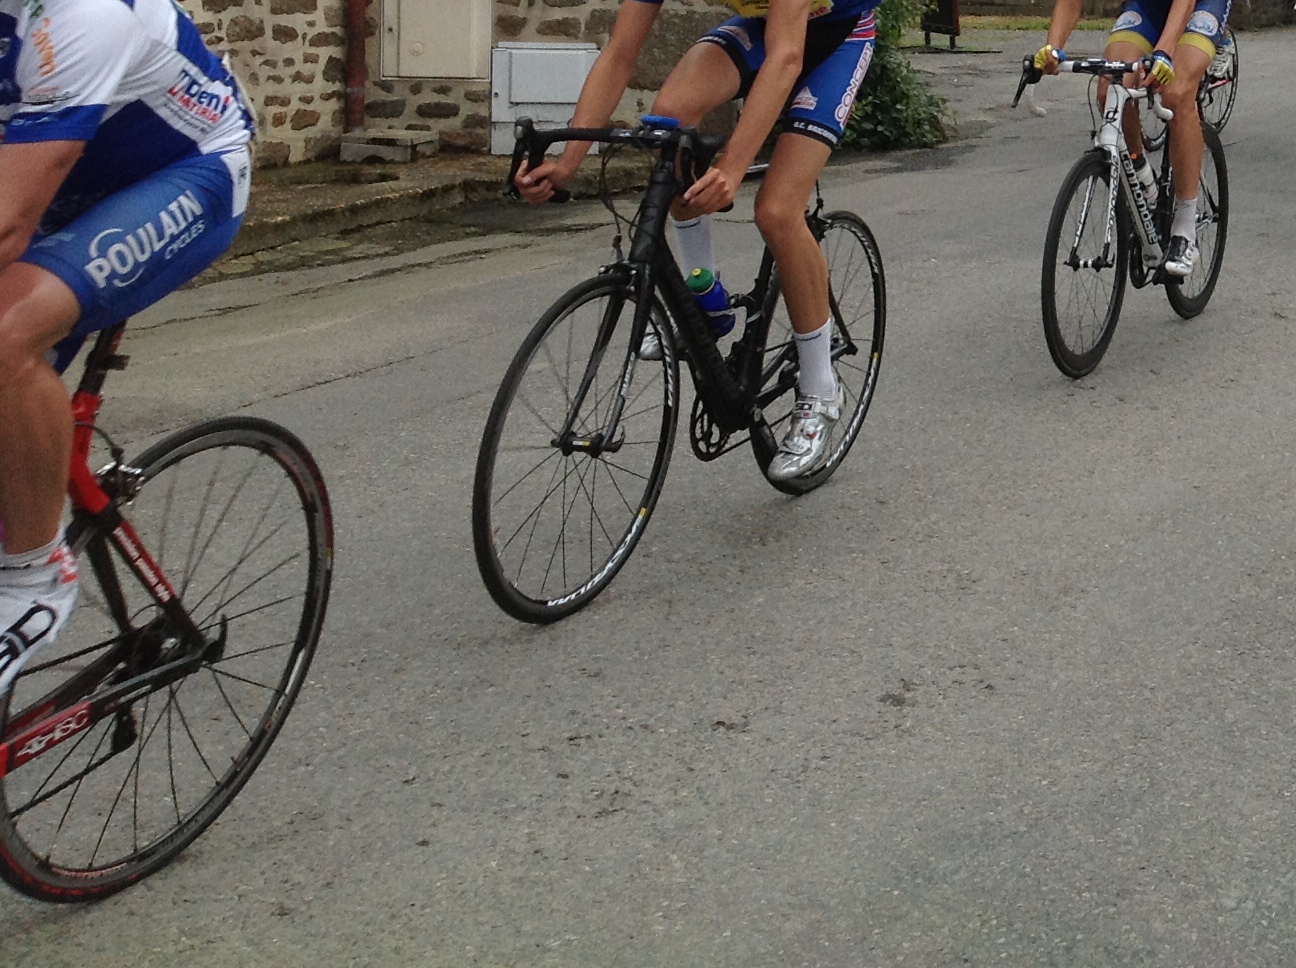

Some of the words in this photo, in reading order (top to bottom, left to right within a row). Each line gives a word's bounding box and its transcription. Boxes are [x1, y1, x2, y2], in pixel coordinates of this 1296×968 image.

[834, 41, 873, 122] CONCEPT
[83, 189, 204, 289] POULAIN
[1119, 151, 1159, 245] cannondale
